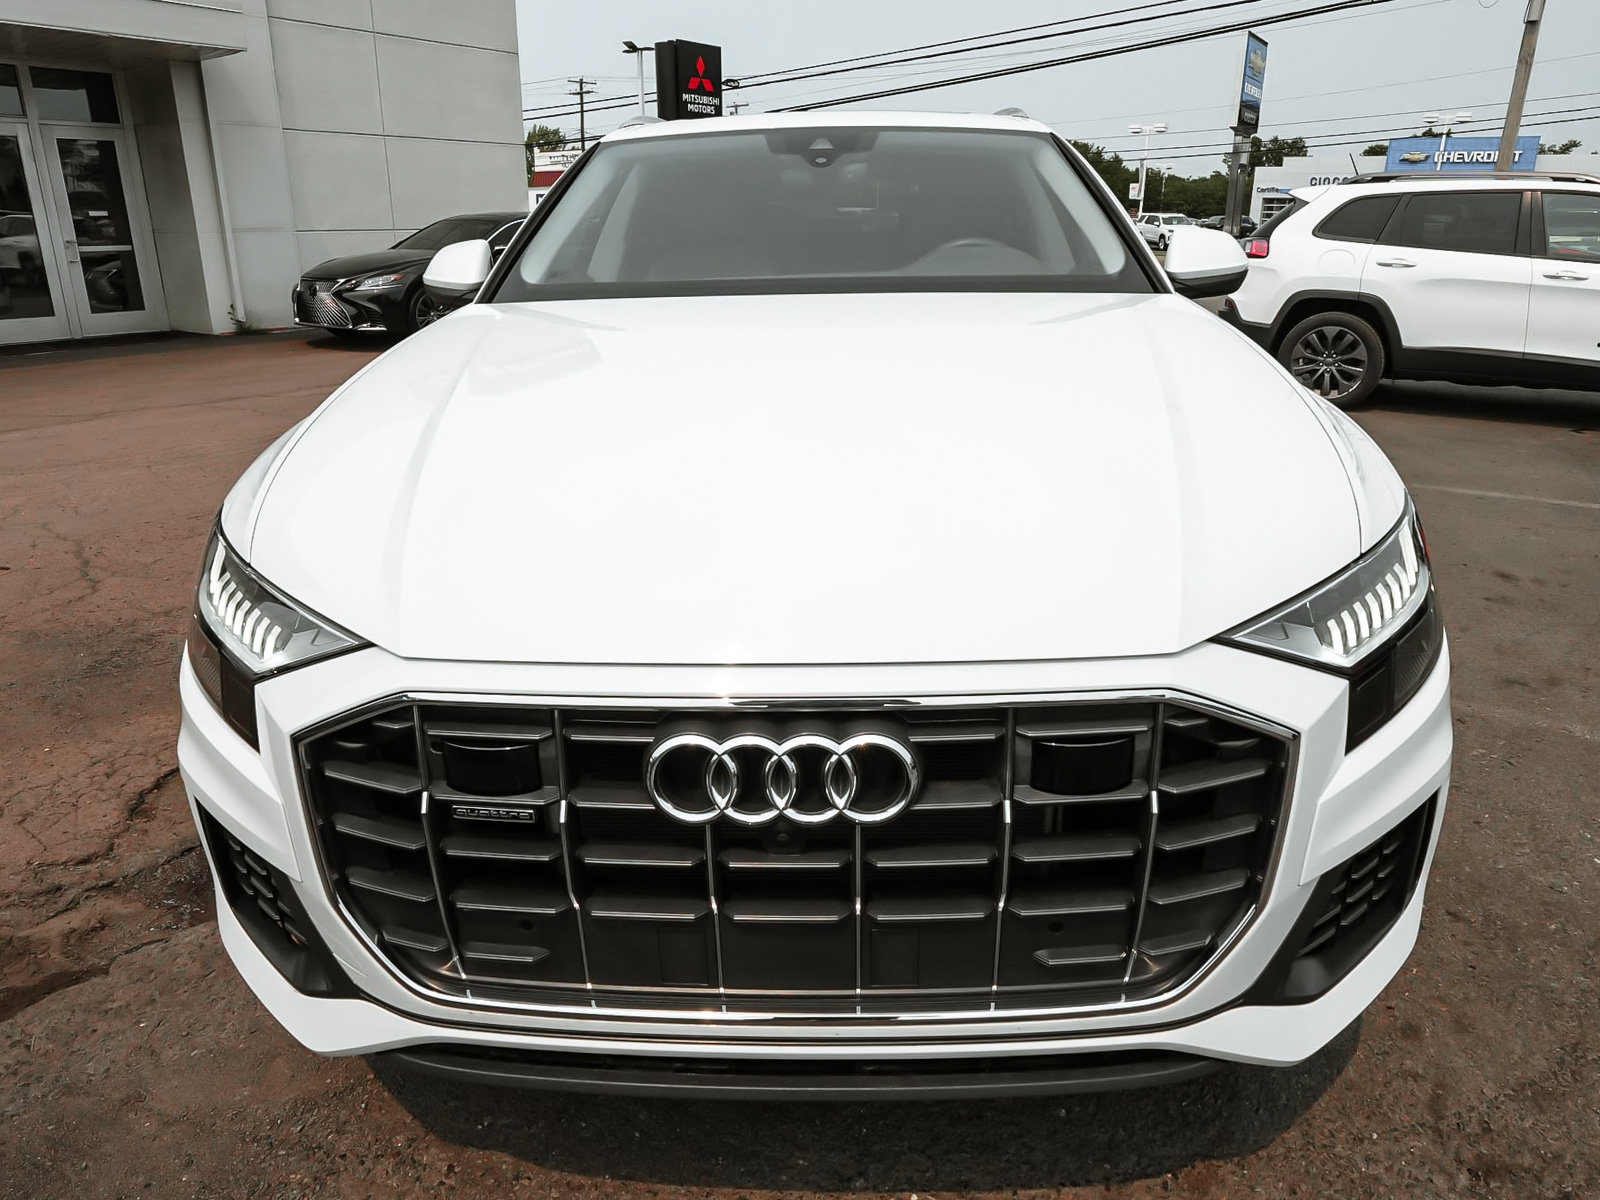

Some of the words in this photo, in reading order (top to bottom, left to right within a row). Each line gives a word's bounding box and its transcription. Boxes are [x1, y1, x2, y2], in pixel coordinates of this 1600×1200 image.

[682, 93, 720, 106] MITSUBISHI
[687, 103, 716, 115] MOTORS
[456, 808, 530, 819] quattro
